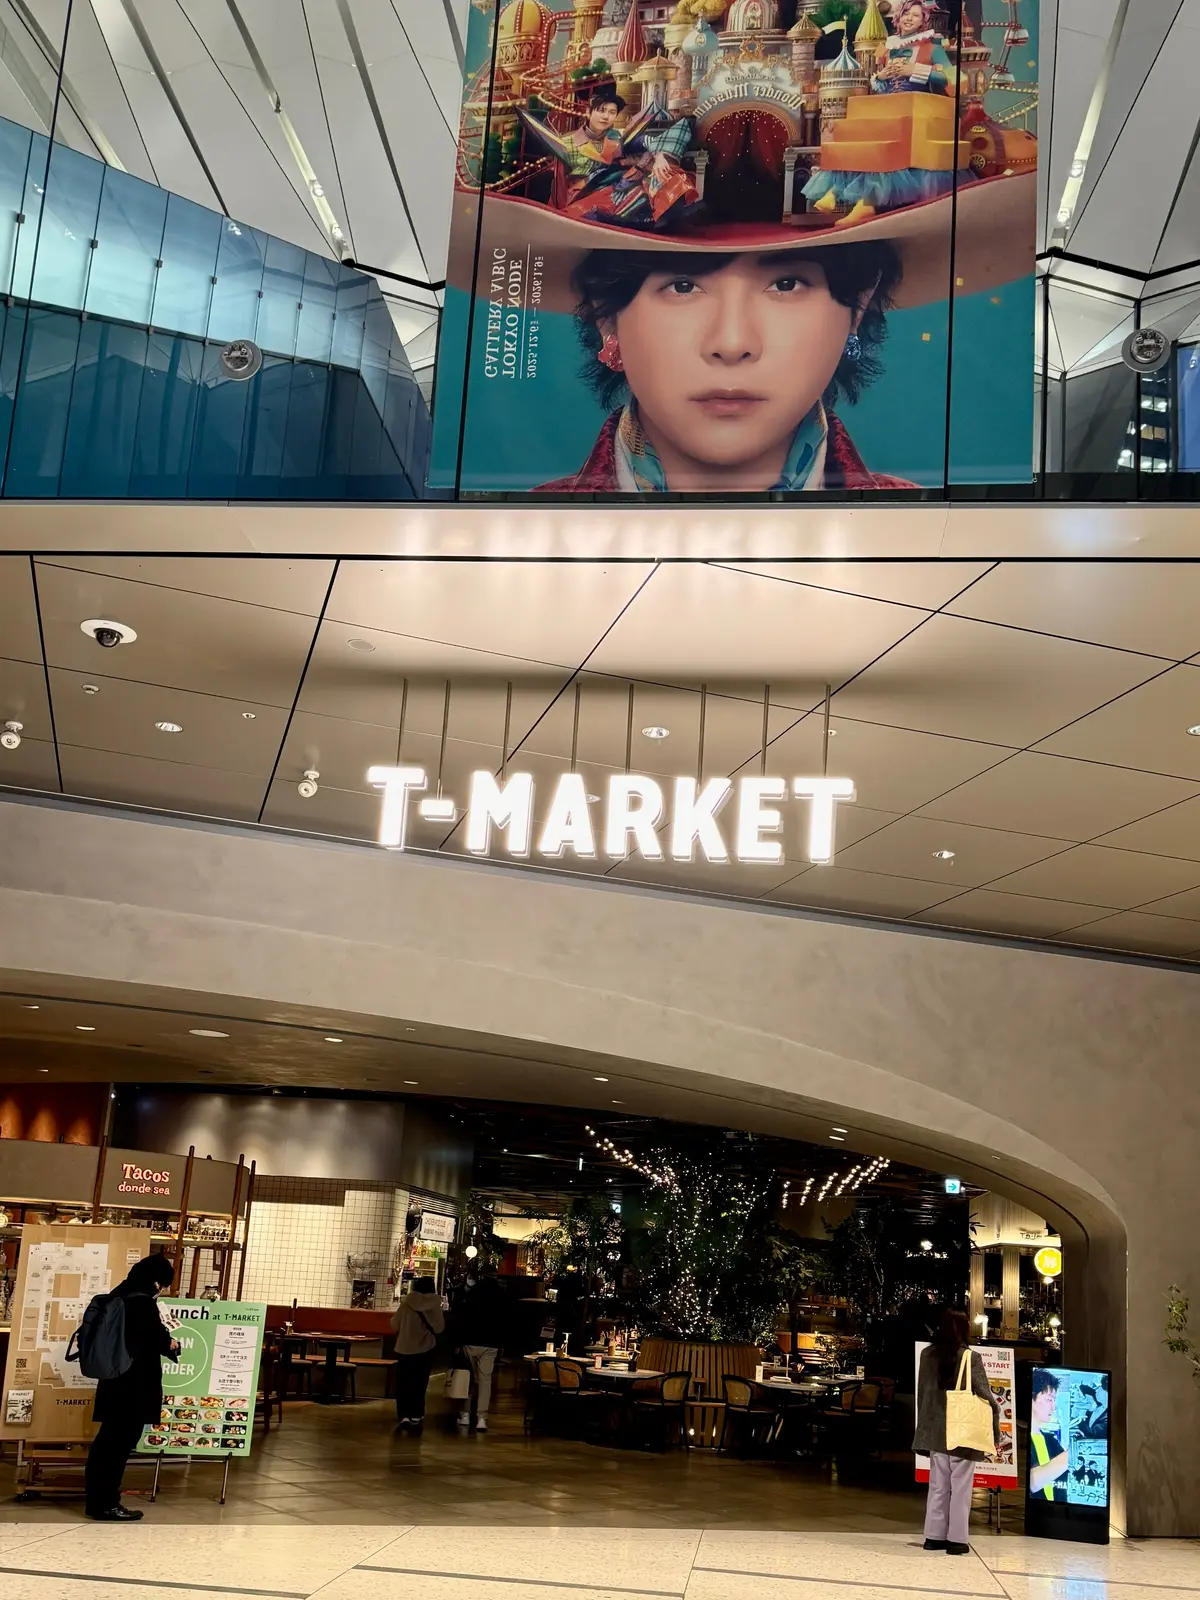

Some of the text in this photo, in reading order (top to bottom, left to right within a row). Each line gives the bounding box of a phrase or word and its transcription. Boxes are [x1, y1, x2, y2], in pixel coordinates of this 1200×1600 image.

[367, 766, 855, 865] T-MARKET
[123, 1163, 170, 1183] Tacos
[118, 1181, 170, 1195] donde sea
[170, 1306, 209, 1320] unch
[225, 1313, 260, 1322] T-MARKET
[162, 1362, 195, 1375] RDER
